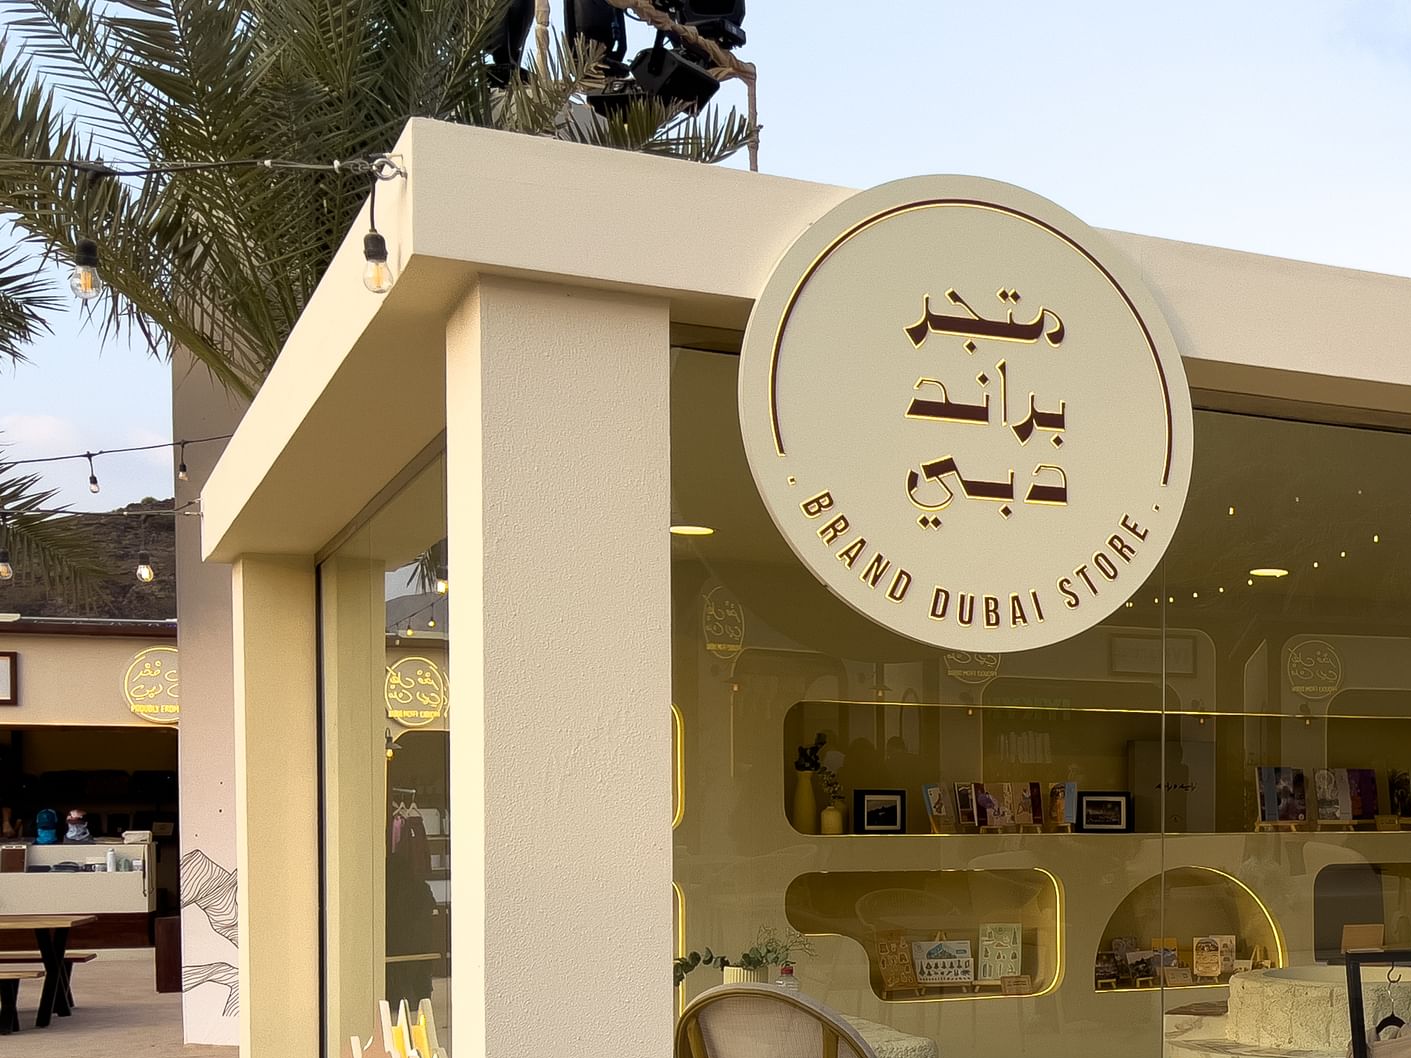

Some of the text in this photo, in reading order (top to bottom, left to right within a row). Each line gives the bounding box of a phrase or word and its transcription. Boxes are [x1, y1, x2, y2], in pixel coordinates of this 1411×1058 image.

[904, 288, 1066, 353] متجر
[904, 359, 1066, 447] براند
[905, 455, 1068, 530] دبي
[799, 489, 1149, 629] BRAND DUBAI STORE
